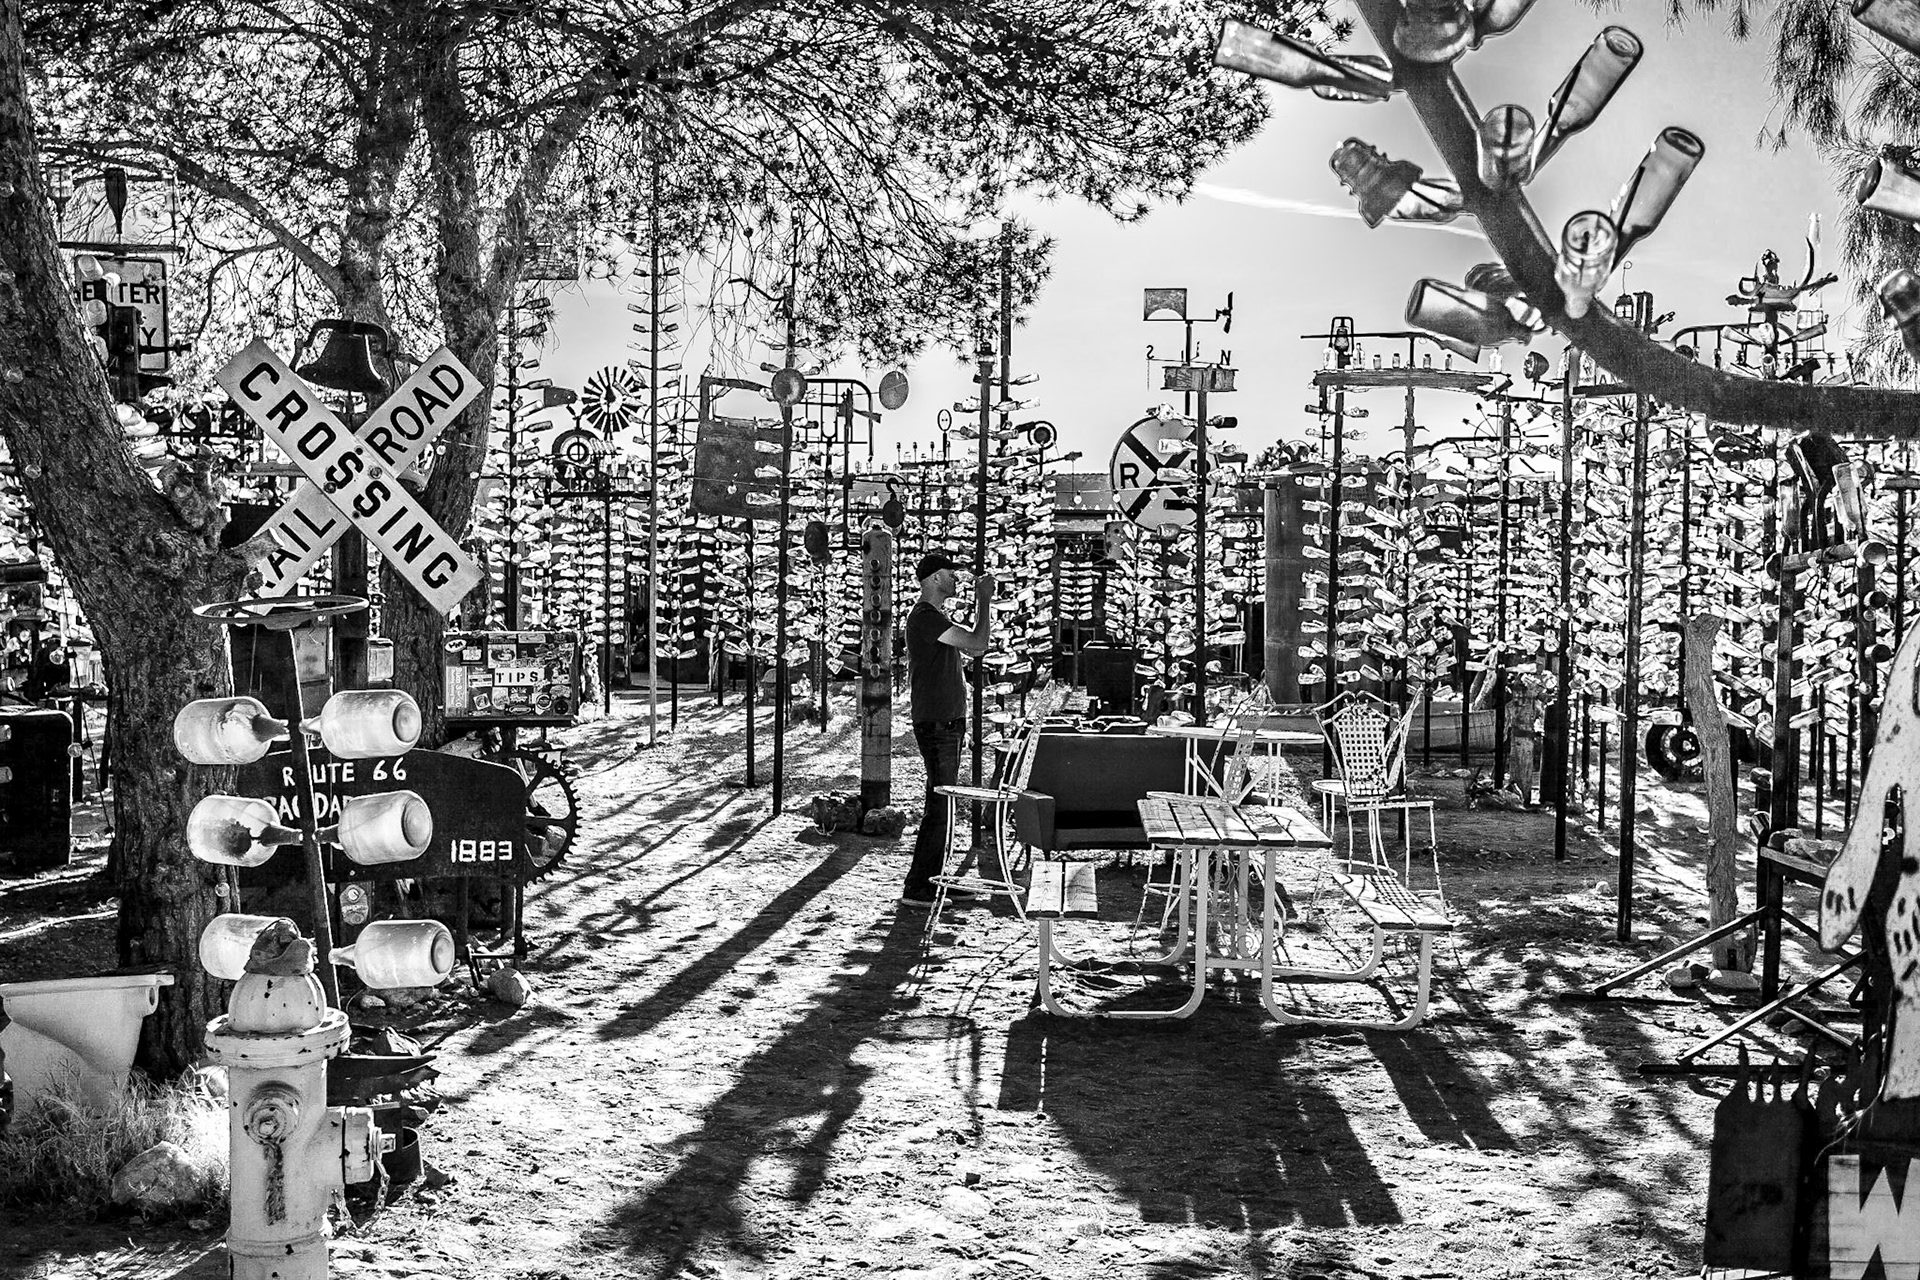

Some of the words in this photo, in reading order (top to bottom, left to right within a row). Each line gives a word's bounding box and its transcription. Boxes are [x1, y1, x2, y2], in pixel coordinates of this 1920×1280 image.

[82, 281, 161, 304] ETER
[239, 362, 459, 589] CROSSING
[262, 507, 337, 591] AIL
[364, 364, 465, 467] ROAD
[1119, 462, 1140, 489] R
[496, 671, 539, 683] TIPS
[282, 762, 355, 786] RUTE
[373, 757, 407, 782] 66
[451, 839, 513, 863] 1883
